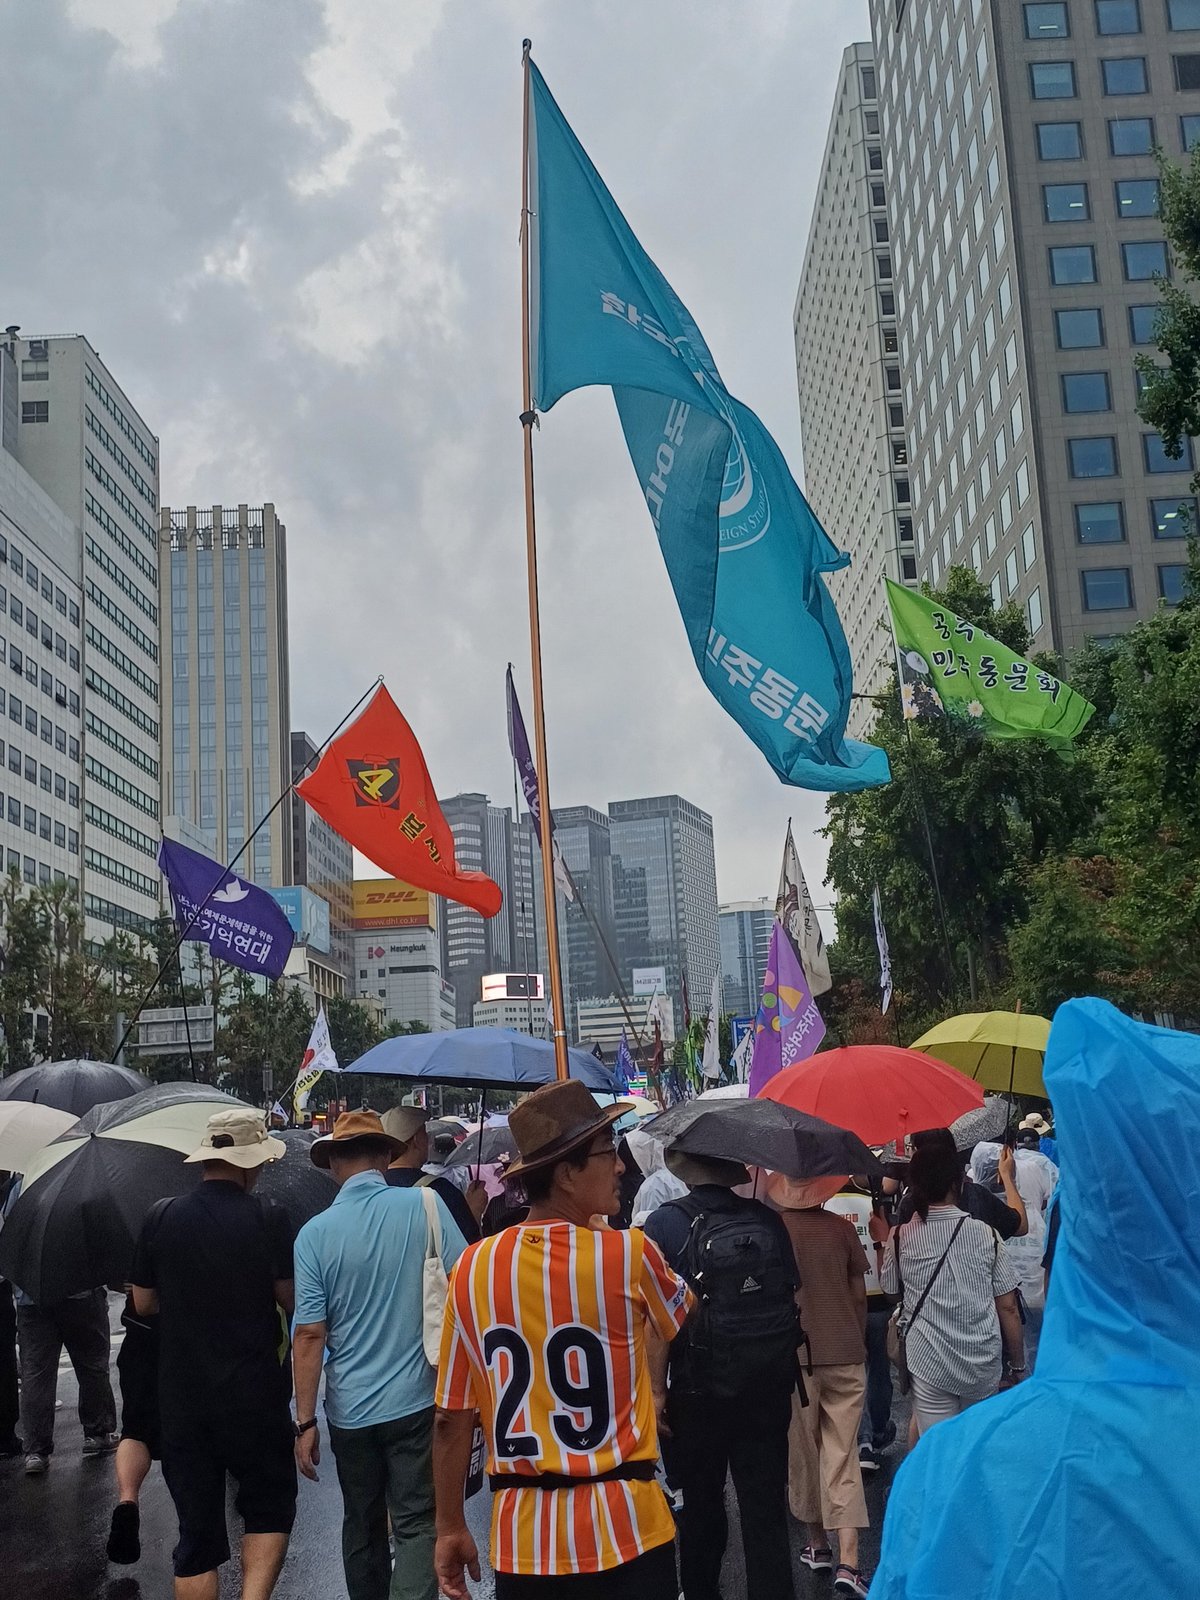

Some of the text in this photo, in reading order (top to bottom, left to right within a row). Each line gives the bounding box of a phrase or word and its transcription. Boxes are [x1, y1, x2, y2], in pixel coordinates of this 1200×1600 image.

[366, 891, 418, 904] DHL
[364, 916, 418, 927] www.dhl.co.kr
[390, 943, 426, 954] Heungkuk
[483, 1324, 614, 1460] 29
